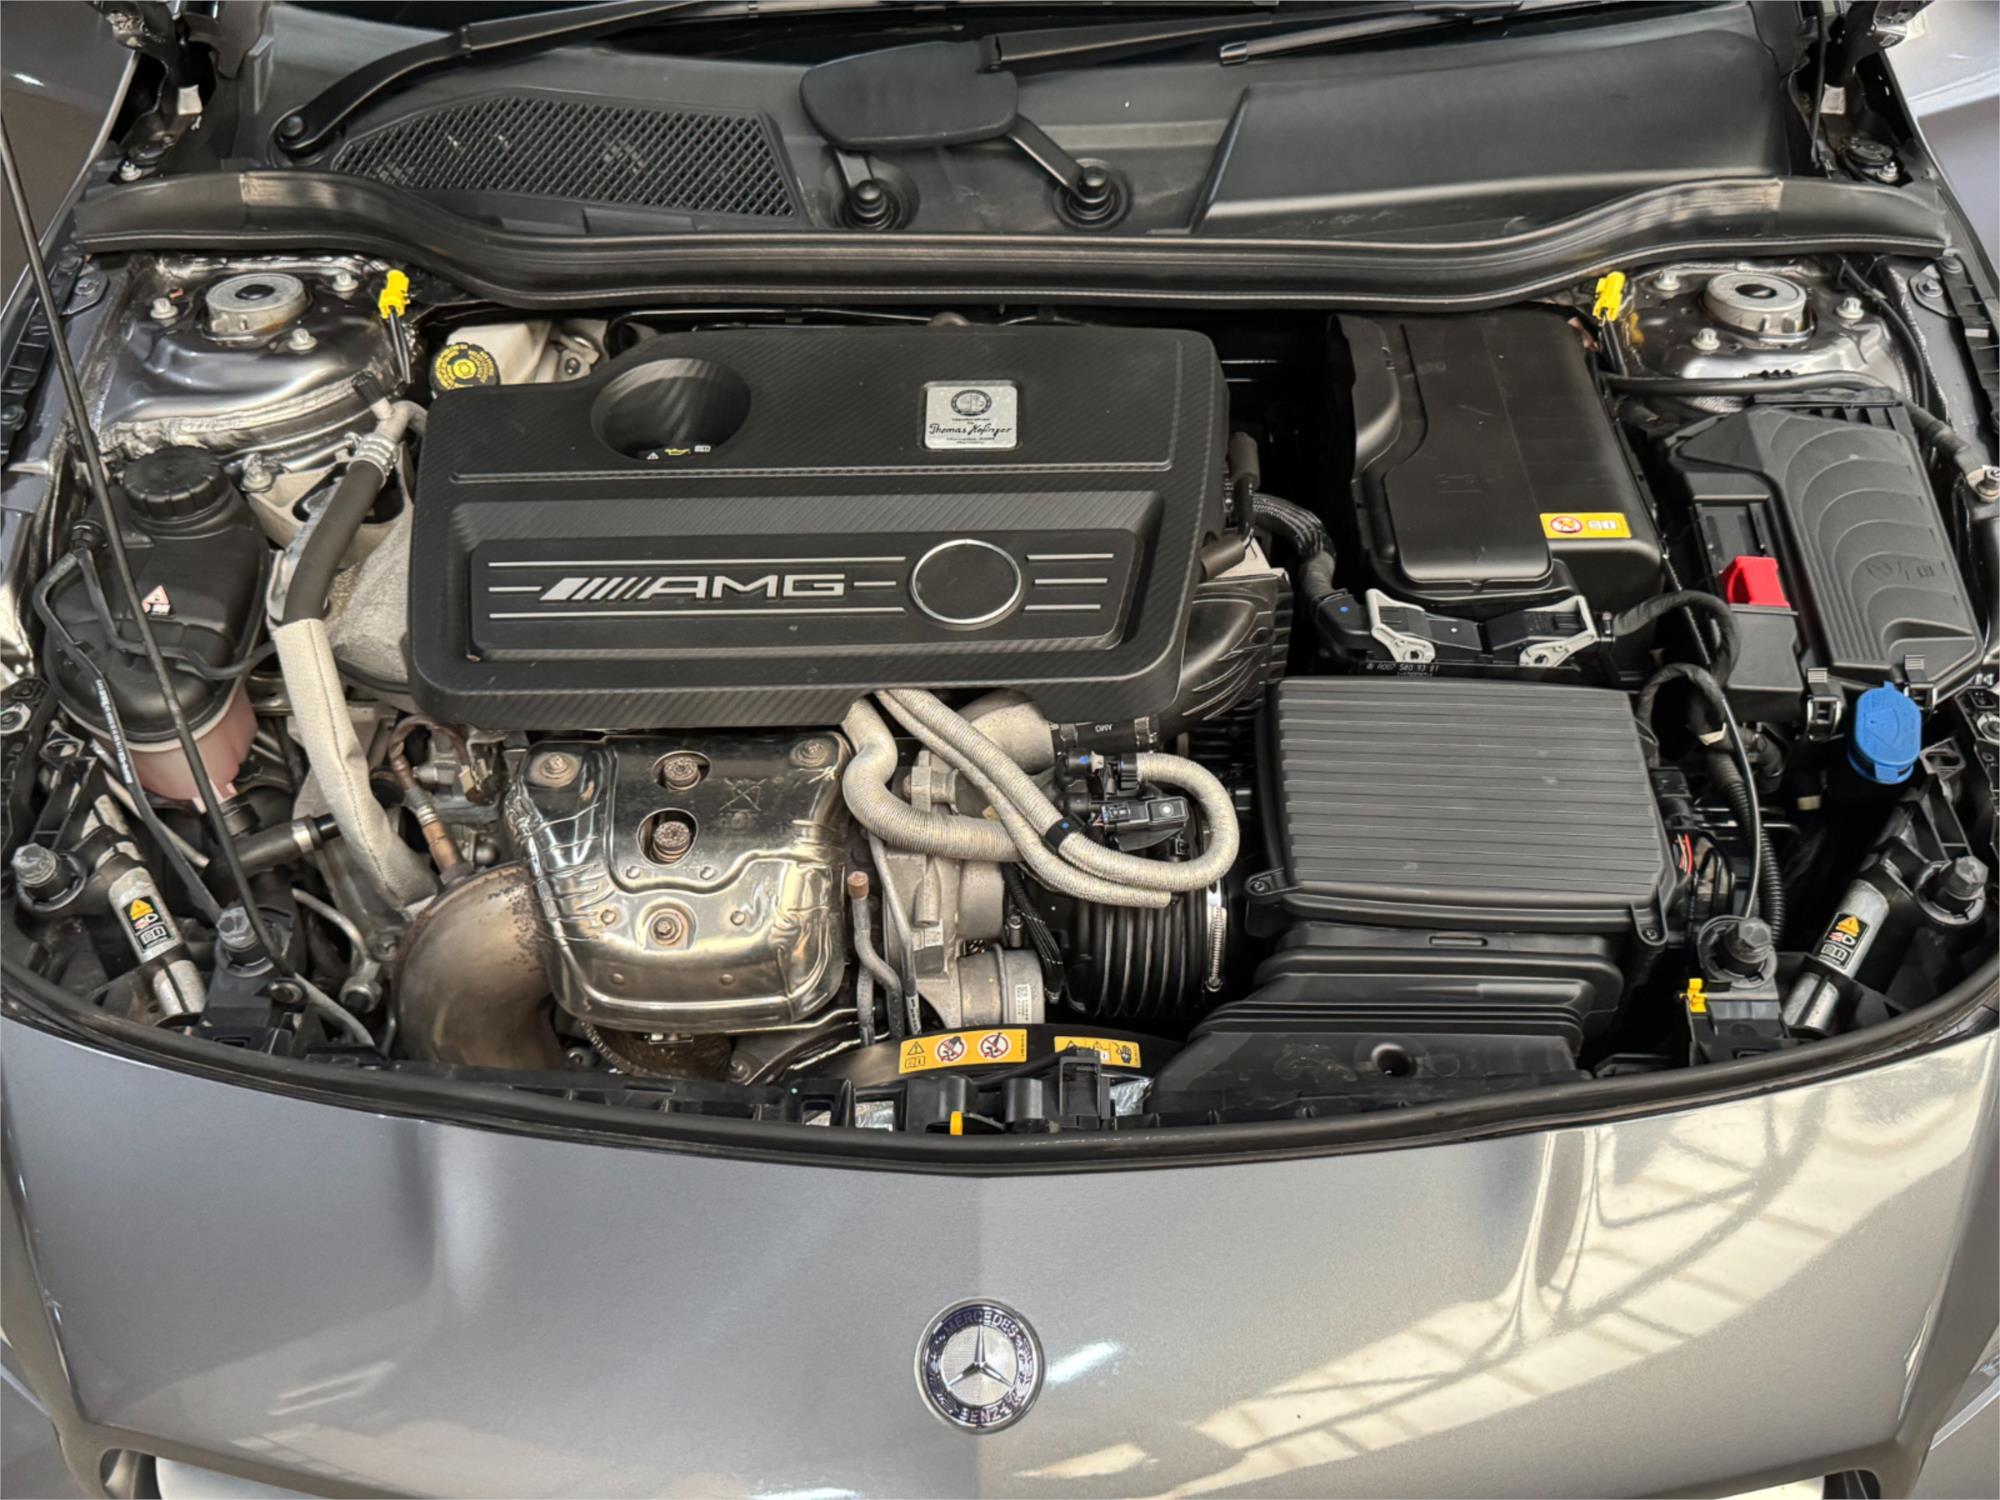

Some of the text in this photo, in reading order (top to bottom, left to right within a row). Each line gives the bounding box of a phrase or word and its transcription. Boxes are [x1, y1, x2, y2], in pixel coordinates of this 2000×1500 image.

[929, 422, 967, 434] Thomas
[637, 574, 845, 599] AMG
[943, 1309, 1019, 1338] MERCEDES
[958, 1406, 1002, 1424] BENZ
